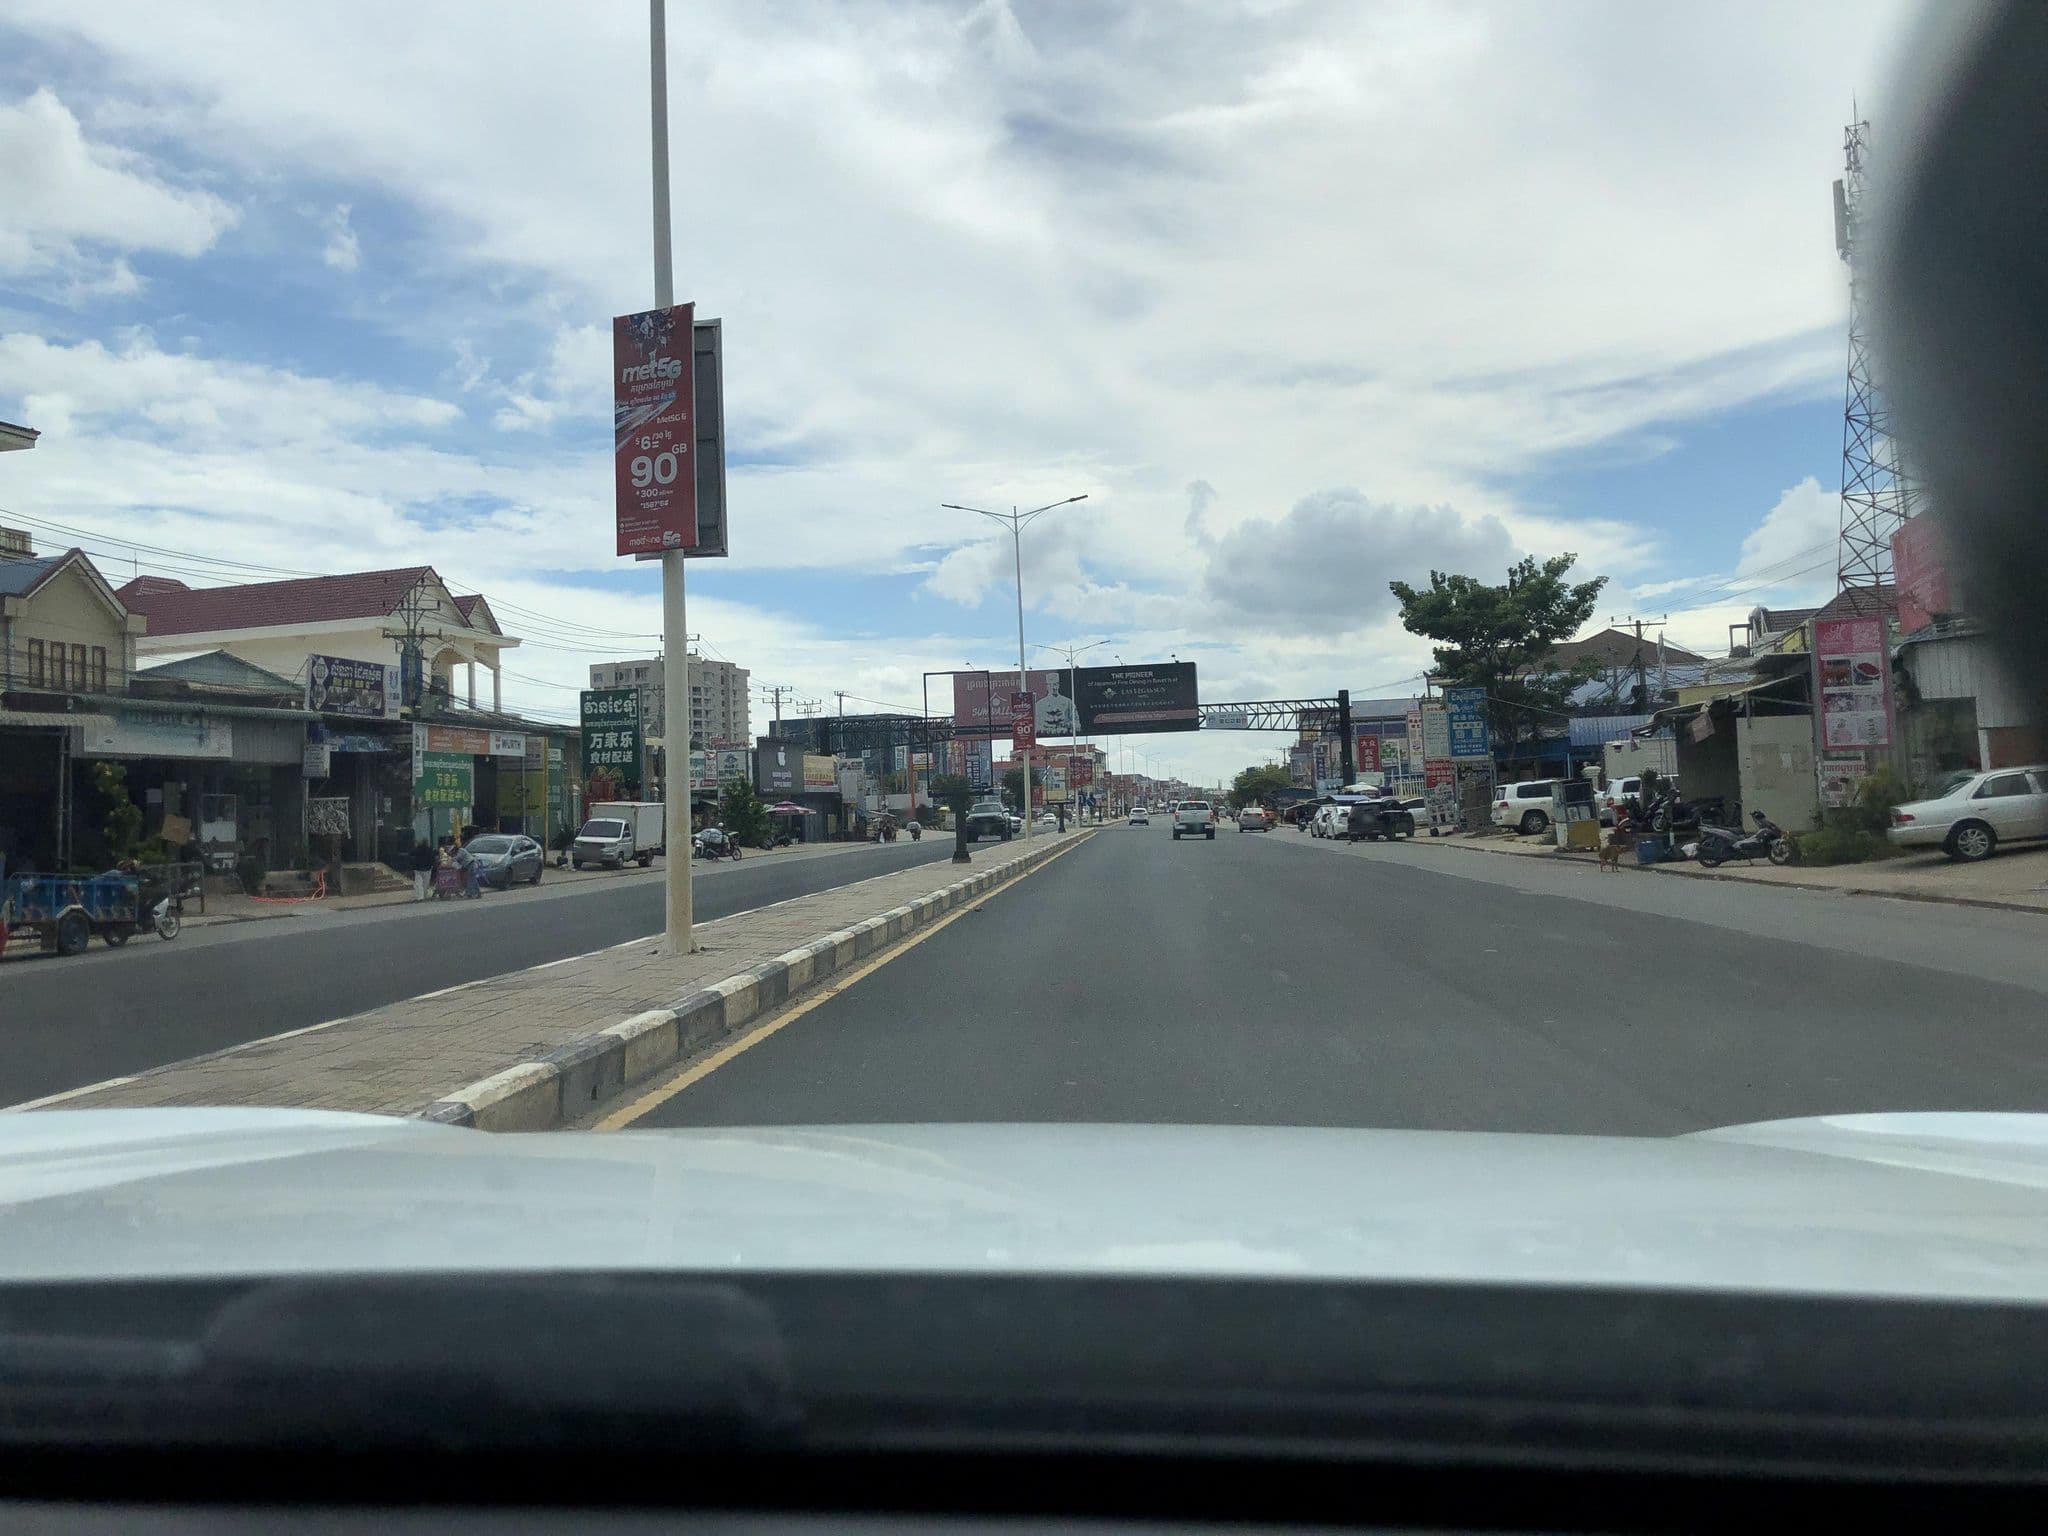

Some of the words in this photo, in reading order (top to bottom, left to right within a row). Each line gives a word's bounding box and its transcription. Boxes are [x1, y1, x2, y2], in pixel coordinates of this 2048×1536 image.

[672, 443, 688, 455] GB
[630, 452, 678, 488] 90
[1125, 671, 1154, 679] PIONEER
[1017, 725, 1031, 735] 90
[590, 731, 633, 749] 万家乐
[589, 750, 633, 764] 食材配送
